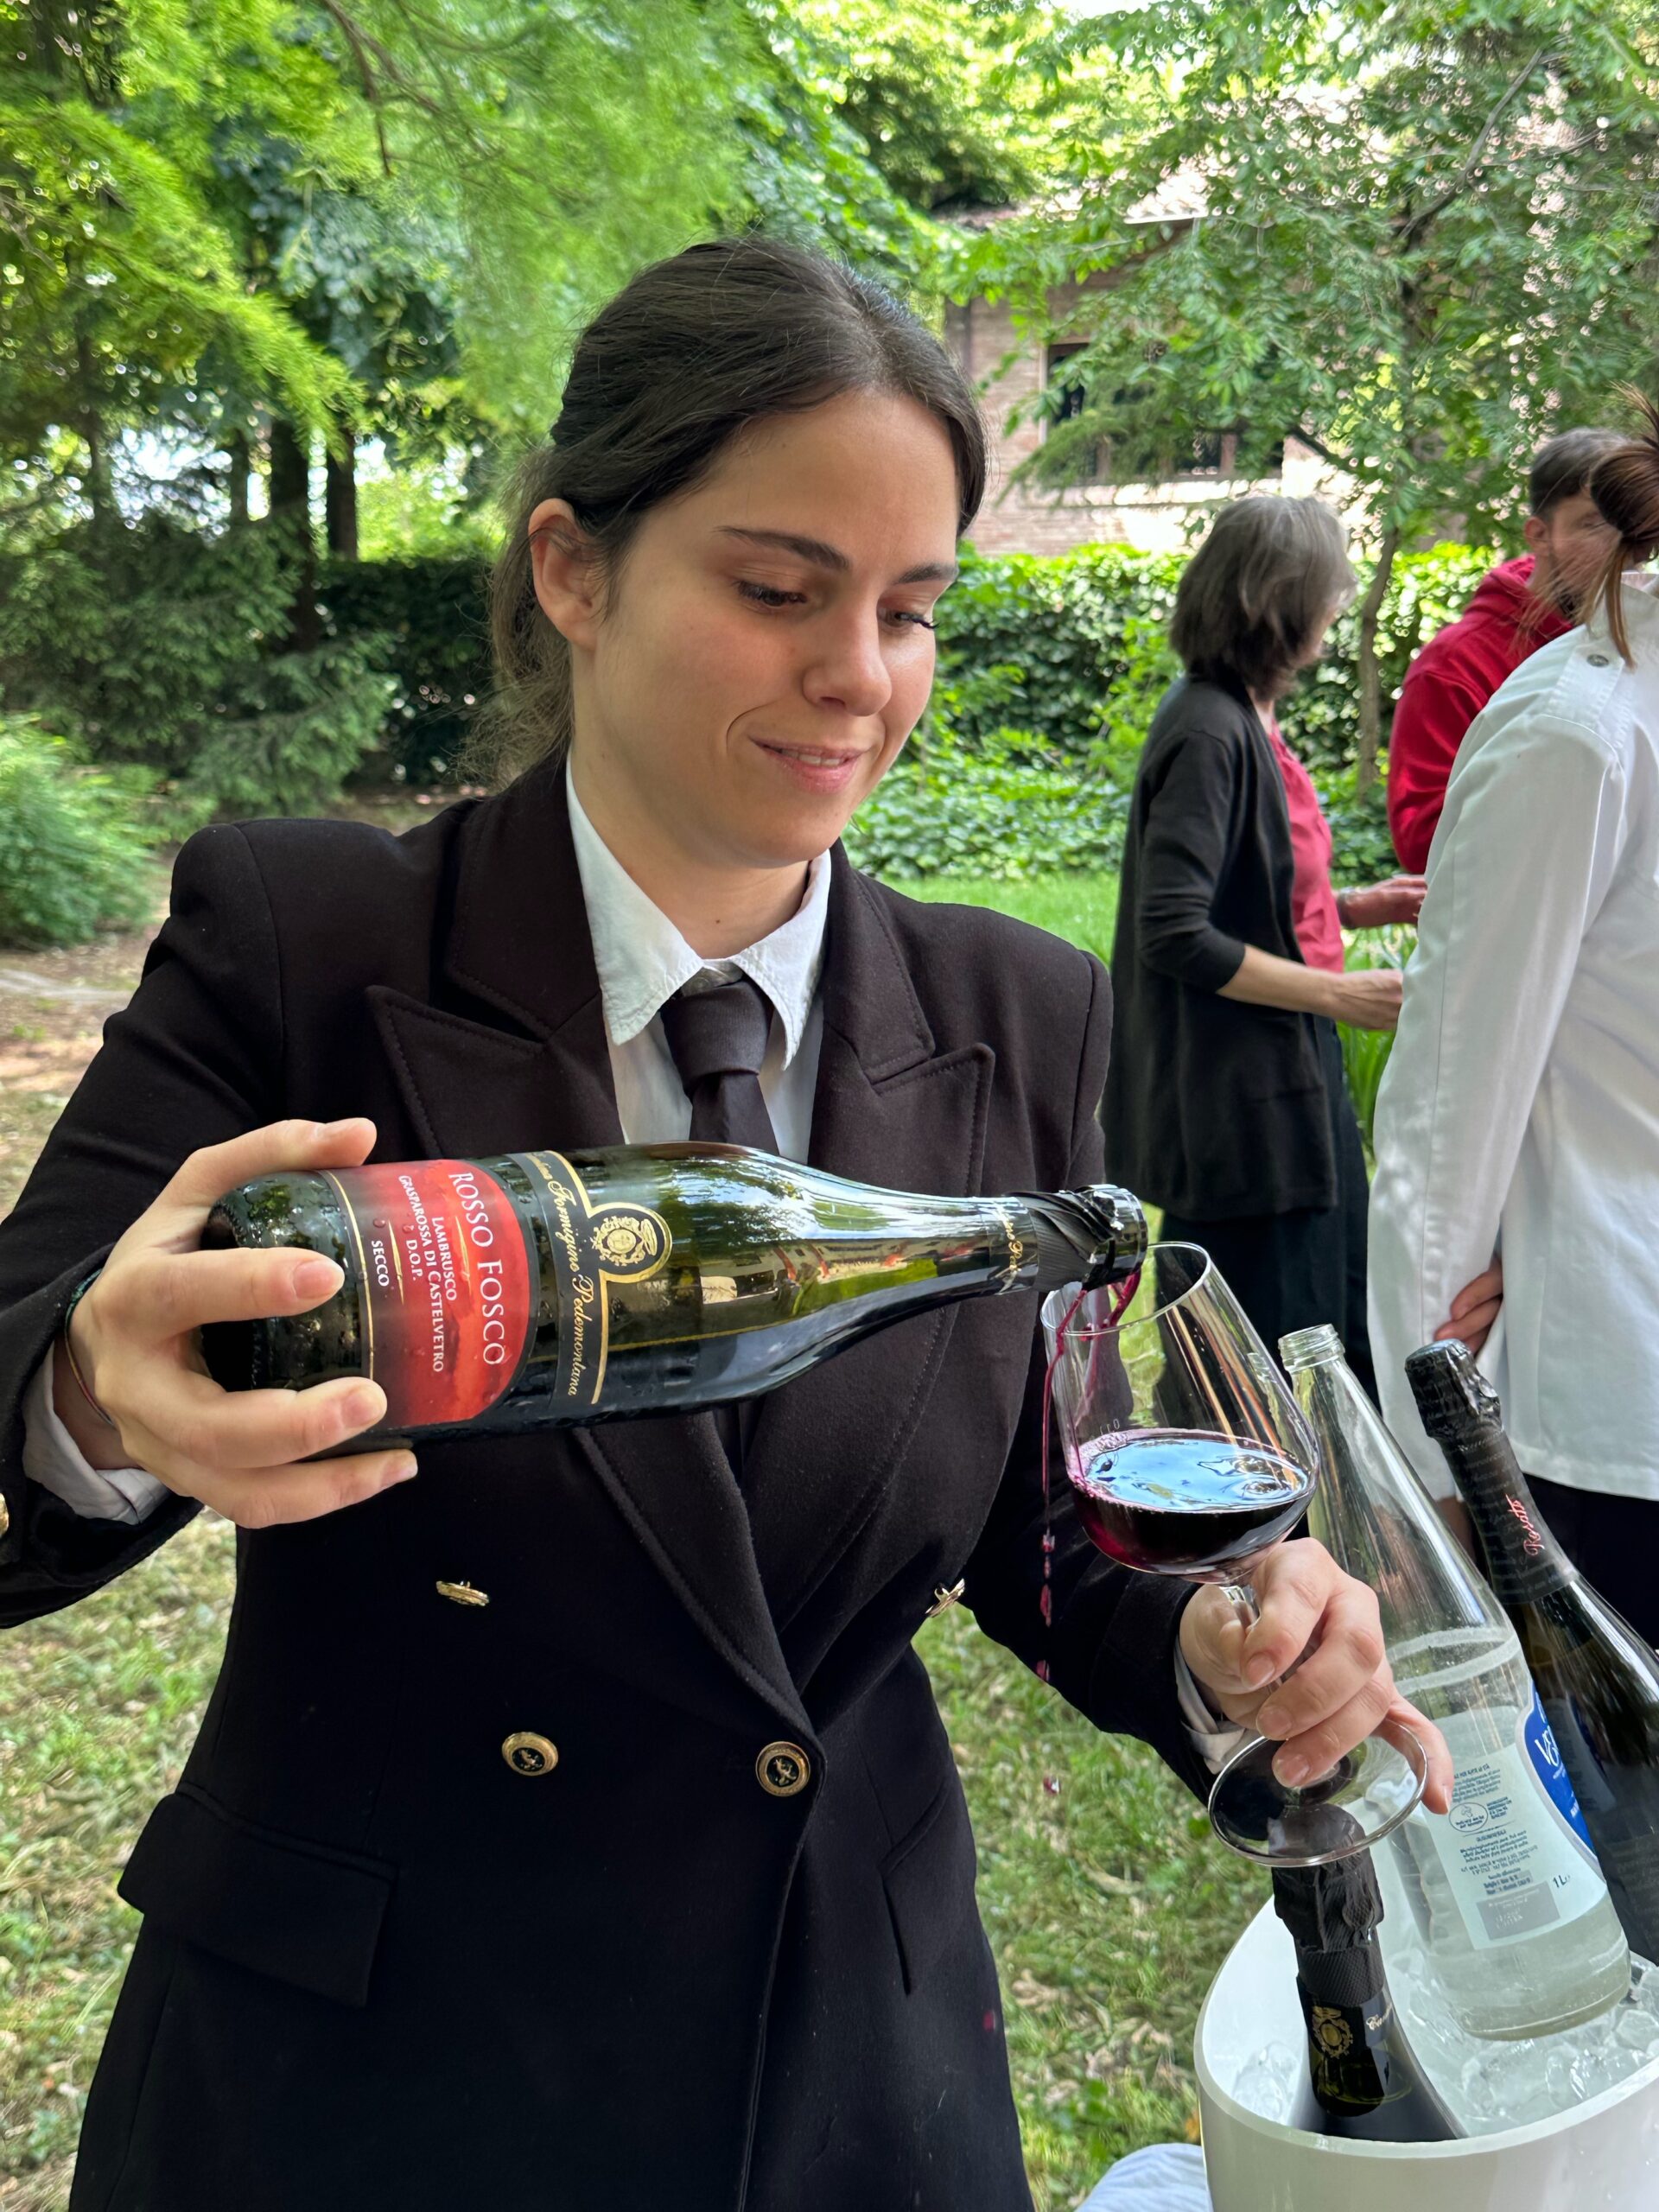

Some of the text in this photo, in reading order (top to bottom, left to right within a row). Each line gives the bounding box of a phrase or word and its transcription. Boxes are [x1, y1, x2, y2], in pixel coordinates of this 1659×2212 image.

[371, 1240, 390, 1287] SECCO
[398, 1175, 444, 1373] GRASPAROSSA DI CASTELVETRO
[405, 1239, 423, 1281] D.O.P.
[431, 1216, 457, 1301] LAMBRUSCO
[448, 1172, 505, 1365] ROSSO FOSCO
[568, 1274, 594, 1396] Pedemontana
[1505, 1494, 1545, 1556] Rosato
